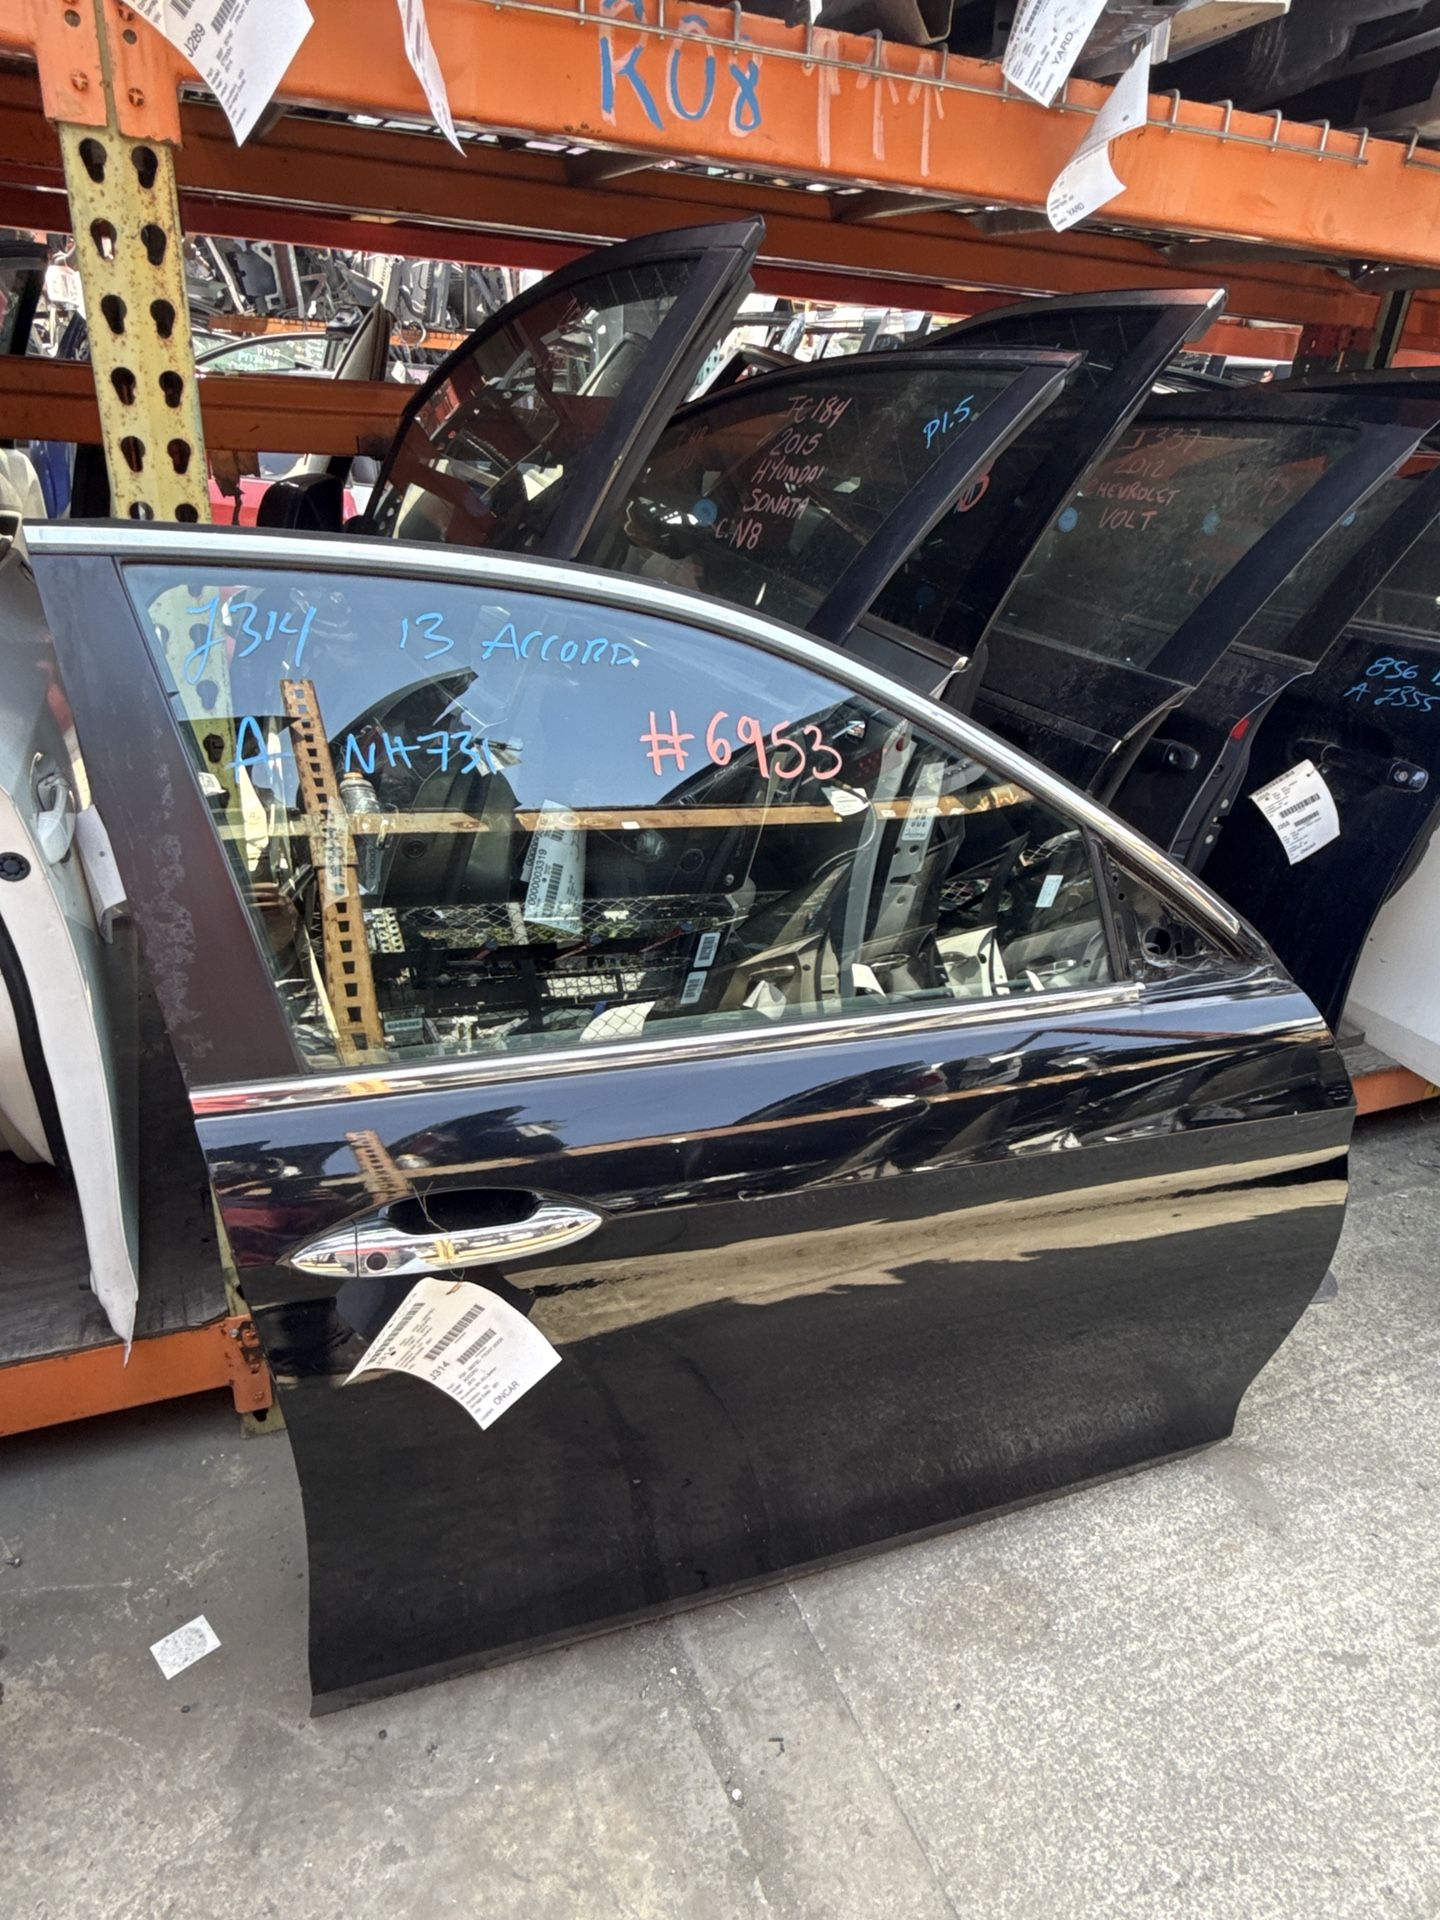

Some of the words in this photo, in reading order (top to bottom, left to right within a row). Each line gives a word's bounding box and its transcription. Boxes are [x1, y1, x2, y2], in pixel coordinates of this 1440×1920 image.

[183, 22, 206, 58] J289
[1051, 31, 1075, 65] YARD
[1066, 202, 1085, 217] YARD
[770, 427, 823, 458] 2015
[751, 456, 825, 488] HYUNDAI
[742, 488, 810, 520] SONATA
[1099, 506, 1158, 531] VOLT
[400, 611, 455, 660] 13
[1343, 682, 1371, 702] A
[639, 708, 844, 780] #6953
[429, 1360, 450, 1381] J314
[492, 1380, 521, 1406] ONCAR
